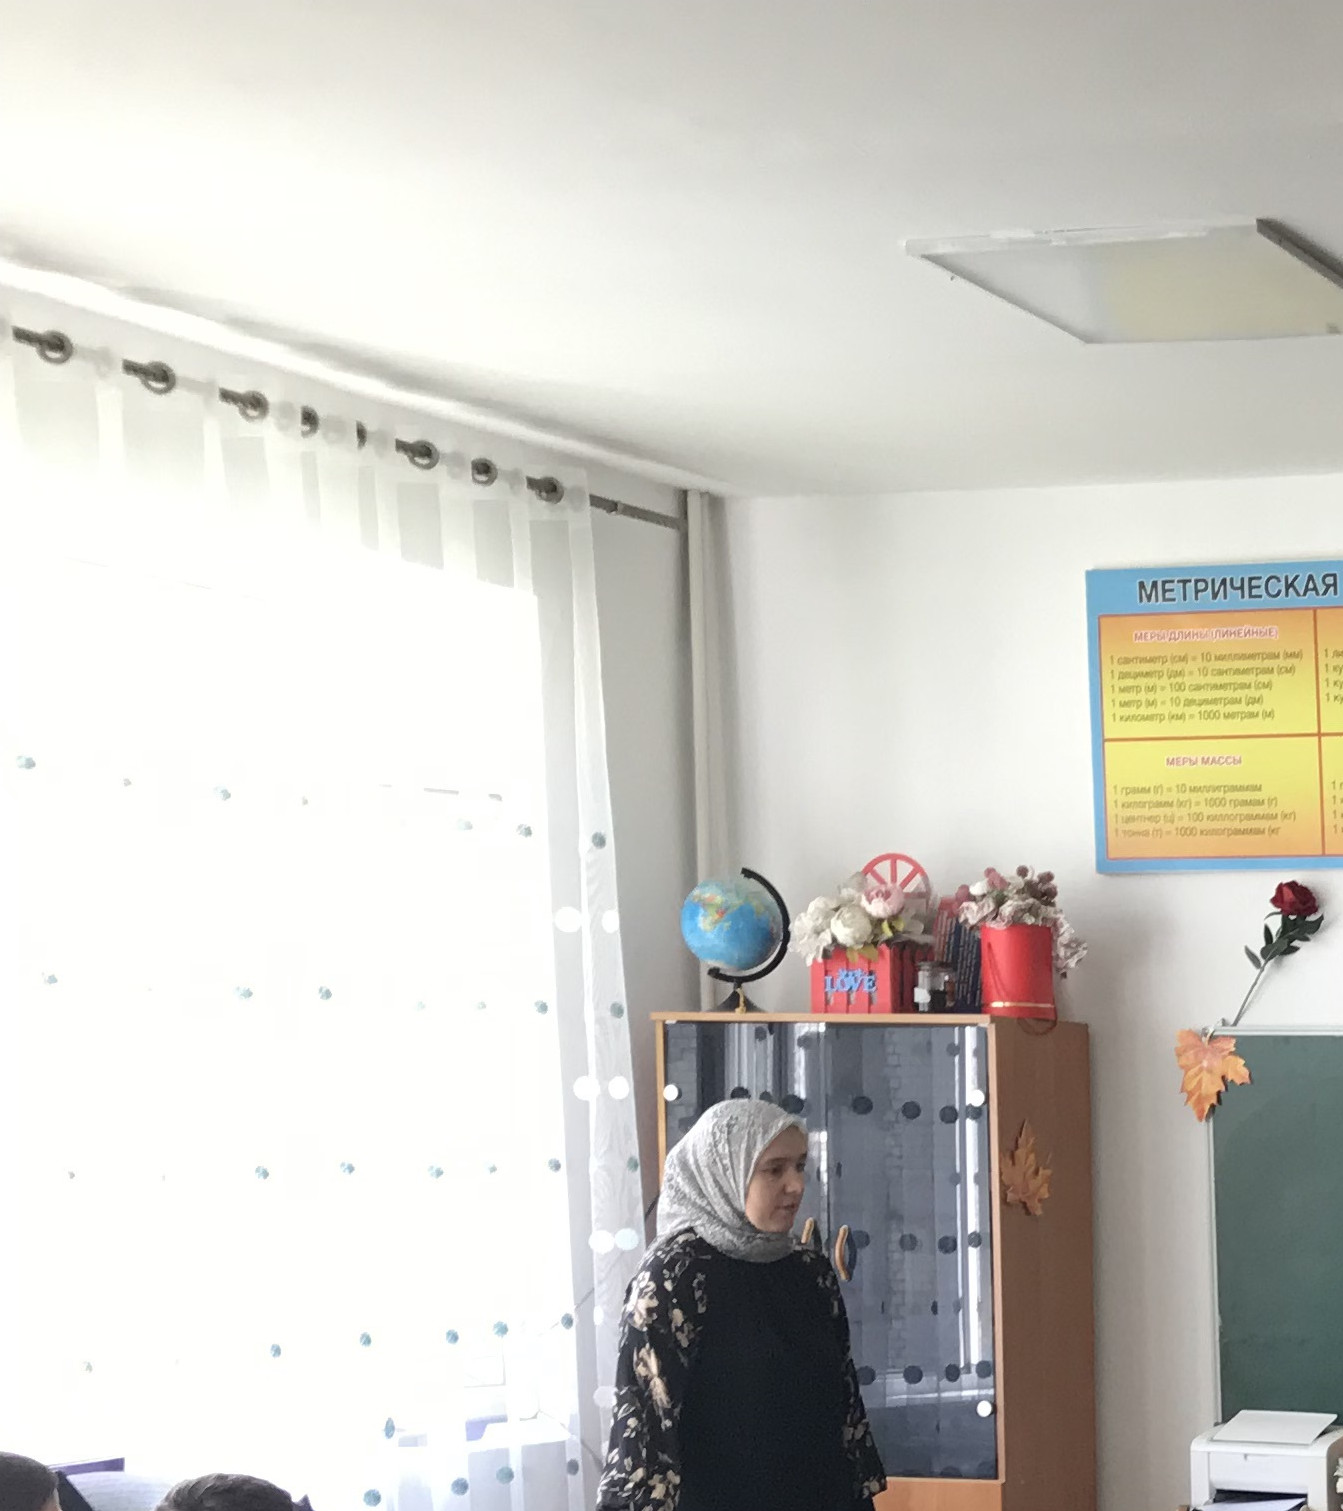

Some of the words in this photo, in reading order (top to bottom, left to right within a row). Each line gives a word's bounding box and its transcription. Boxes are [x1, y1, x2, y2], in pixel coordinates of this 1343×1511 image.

[1138, 568, 1338, 604] МЕТРИЧЕСКАЯ
[1135, 630, 1167, 641] МЕРЫ
[1167, 756, 1198, 767] МЕРЫ
[1201, 755, 1242, 766] МАССЫ
